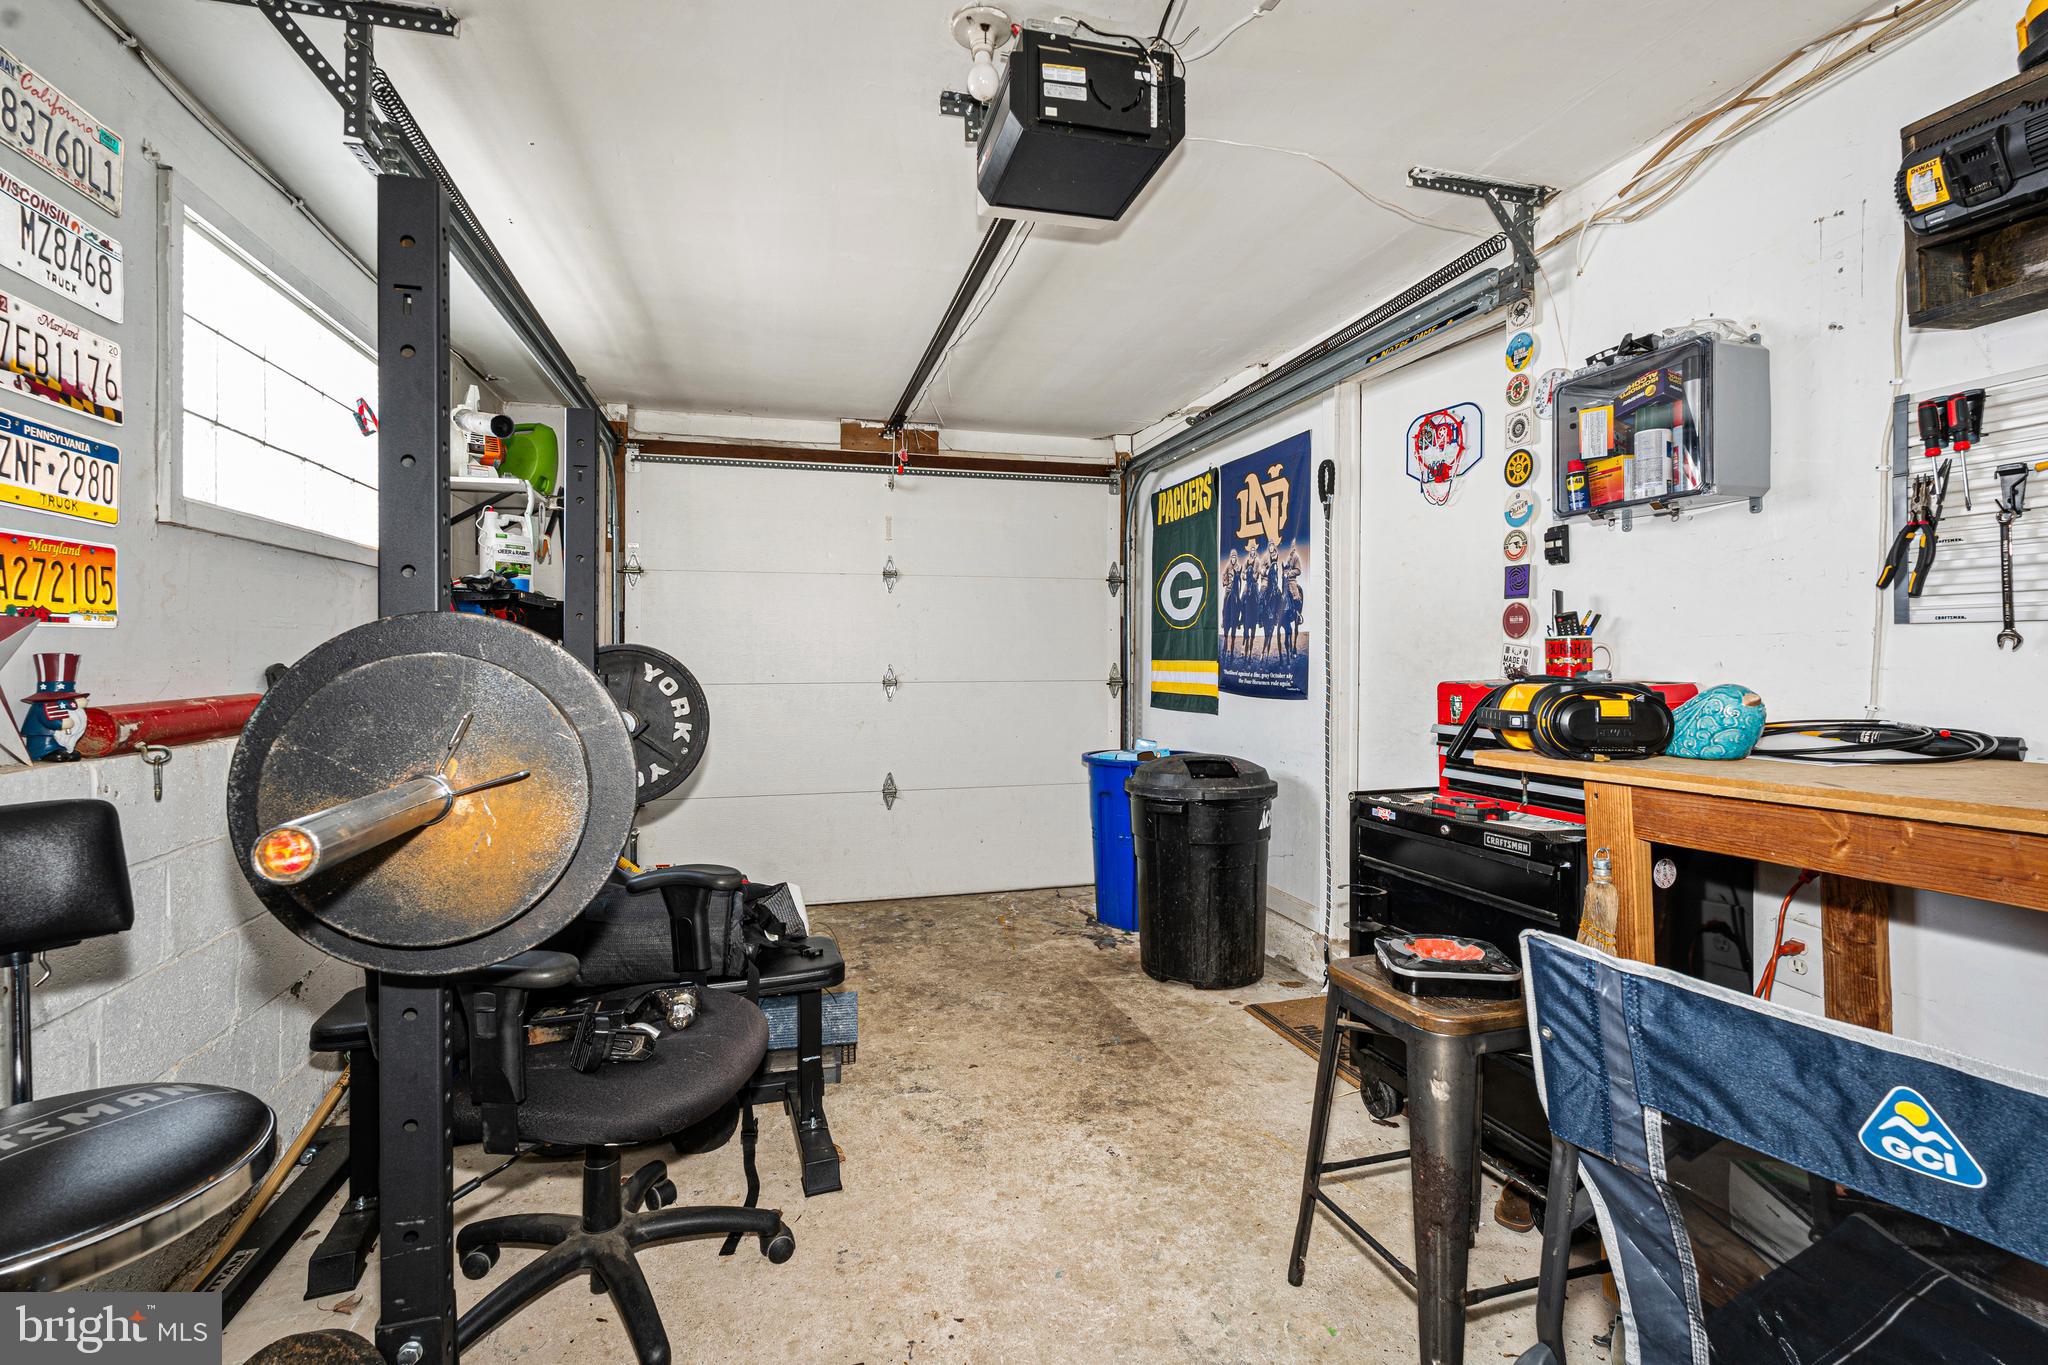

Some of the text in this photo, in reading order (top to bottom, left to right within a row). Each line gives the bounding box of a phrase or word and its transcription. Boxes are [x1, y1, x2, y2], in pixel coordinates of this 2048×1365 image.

[20, 72, 101, 144] California
[21, 204, 112, 295] MZ8468
[46, 269, 78, 295] TRUCK
[38, 314, 79, 340] Maryland
[108, 345, 118, 357] 20
[24, 424, 91, 453] PENNSYLVANIA
[40, 492, 79, 512] TRUCK
[1157, 473, 1212, 526] PACKERS
[28, 538, 82, 558] Maryland
[1161, 561, 1203, 621] G
[1503, 655, 1528, 665] MADE IN
[644, 662, 693, 743] YORK
[1486, 835, 1529, 853] CRAFTSMAN
[1881, 1135, 1958, 1176] GCI
